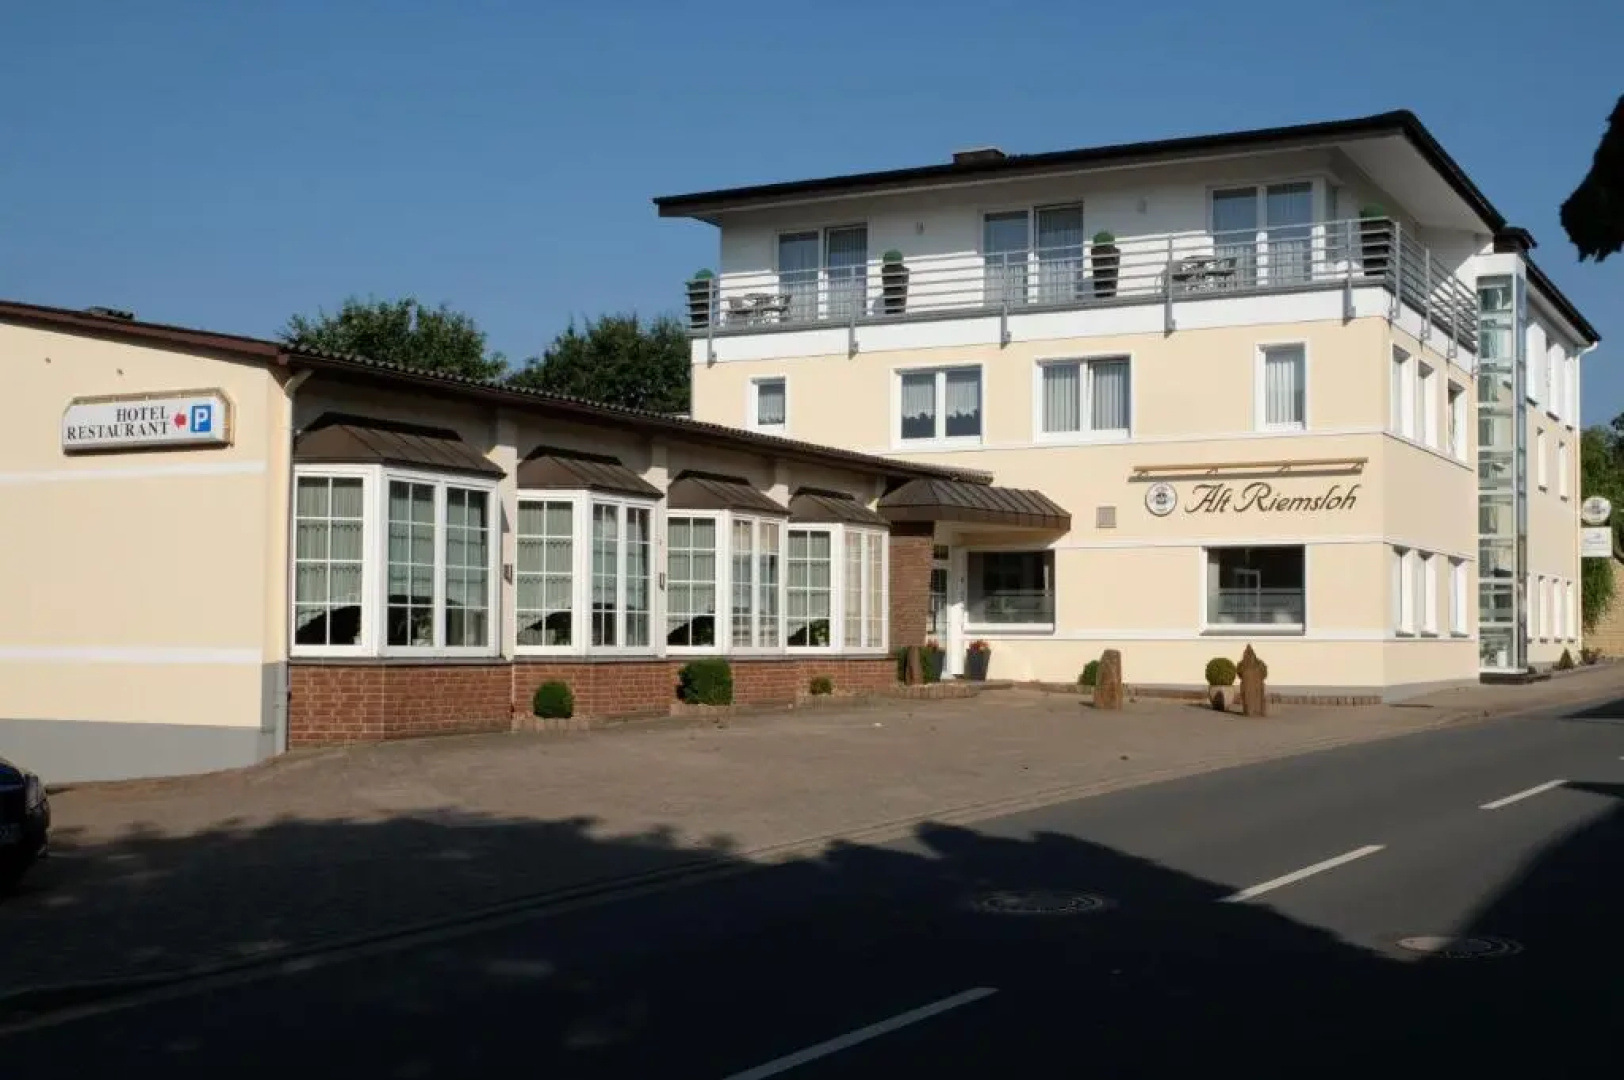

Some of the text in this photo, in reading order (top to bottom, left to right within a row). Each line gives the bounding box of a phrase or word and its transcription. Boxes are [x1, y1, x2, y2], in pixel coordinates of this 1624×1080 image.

[116, 405, 169, 423] HOTEL
[194, 407, 208, 431] P
[67, 421, 169, 441] RESTAURANT
[1184, 481, 1362, 514] Alt Riemsloh
